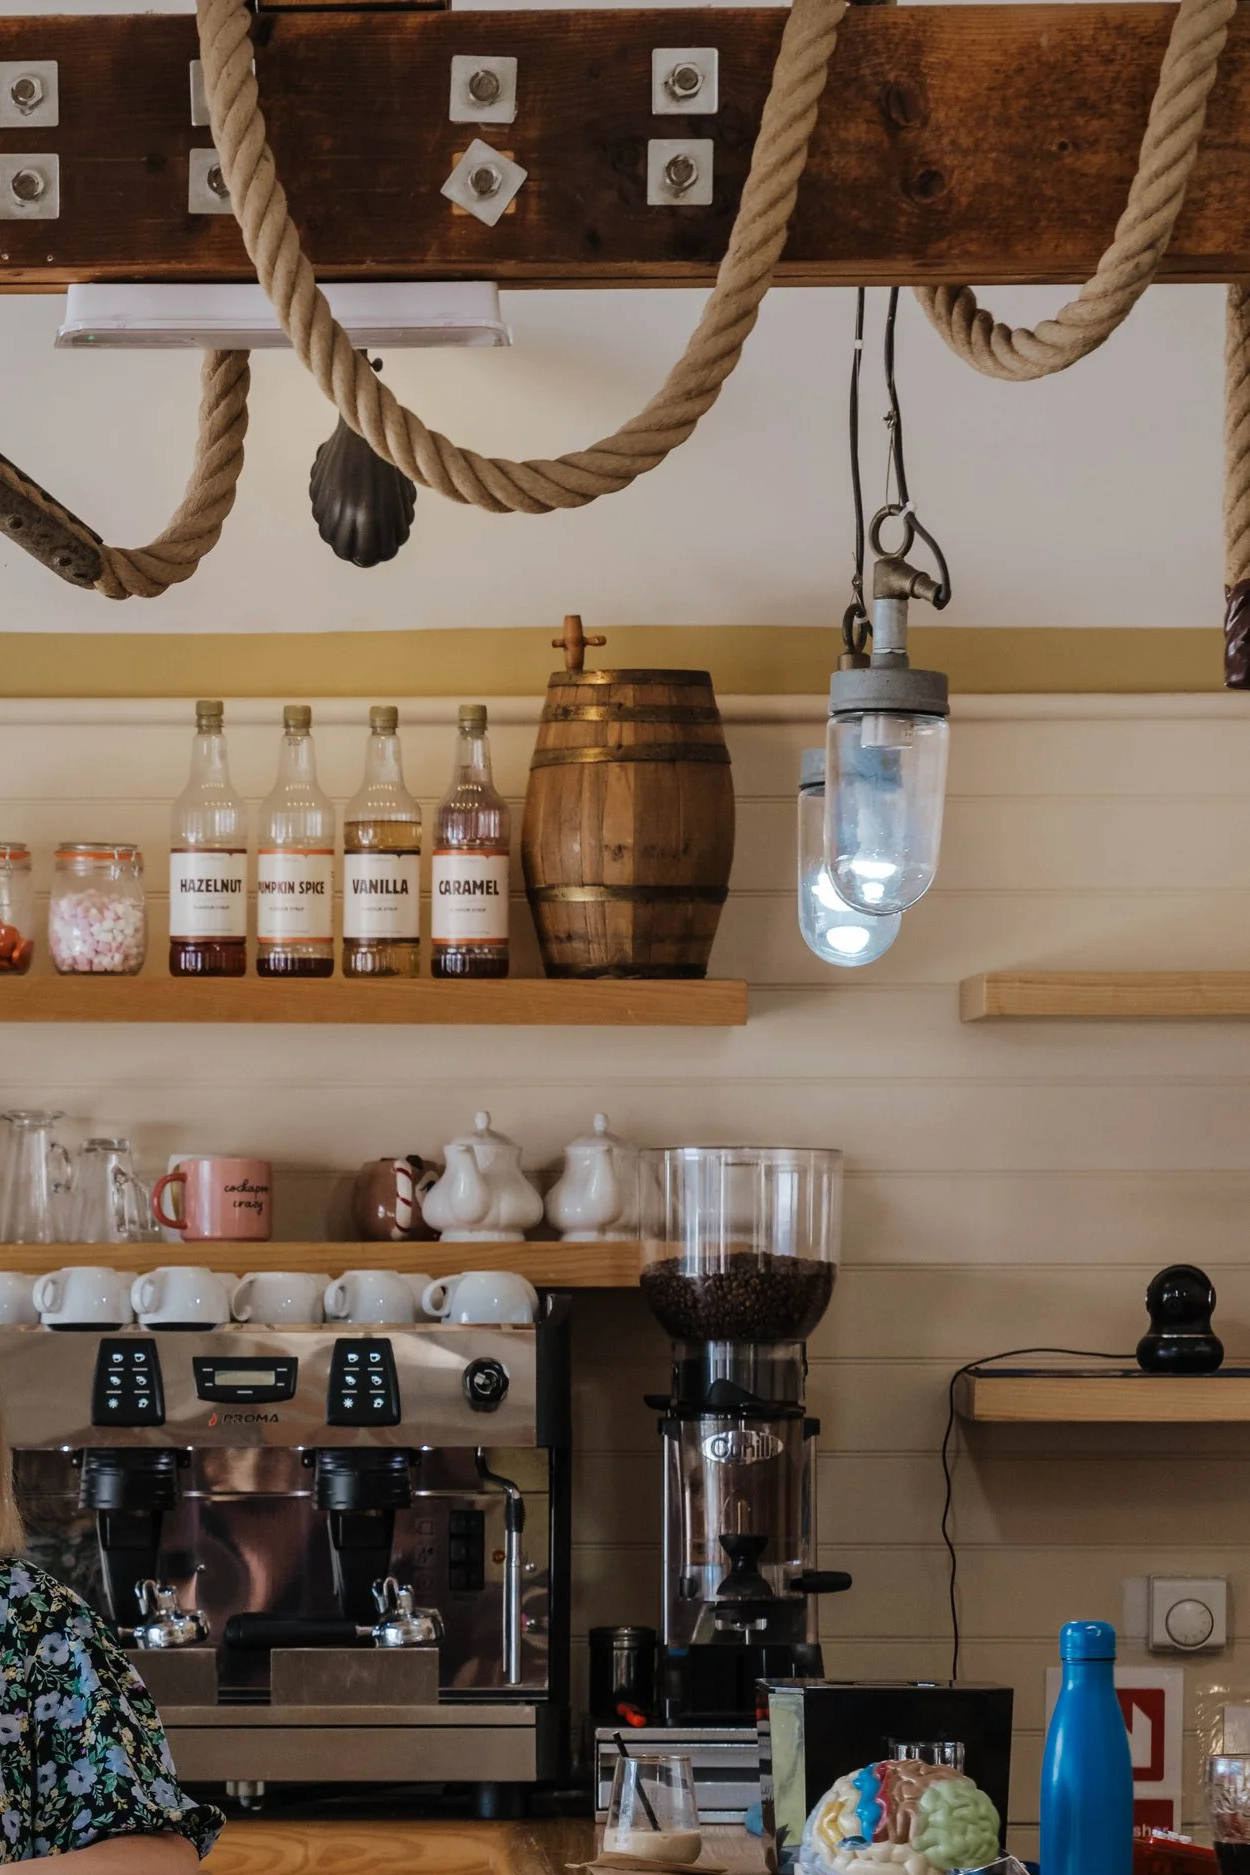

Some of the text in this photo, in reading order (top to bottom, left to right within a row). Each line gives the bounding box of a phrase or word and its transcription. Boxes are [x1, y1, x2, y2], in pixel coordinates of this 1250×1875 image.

[180, 879, 241, 893] HAZELNUT
[299, 881, 324, 894] SPICE
[352, 879, 408, 894] VANILLA
[439, 880, 499, 895] CARAMEL
[233, 1200, 263, 1216] crazy
[222, 1414, 279, 1423] PROMA
